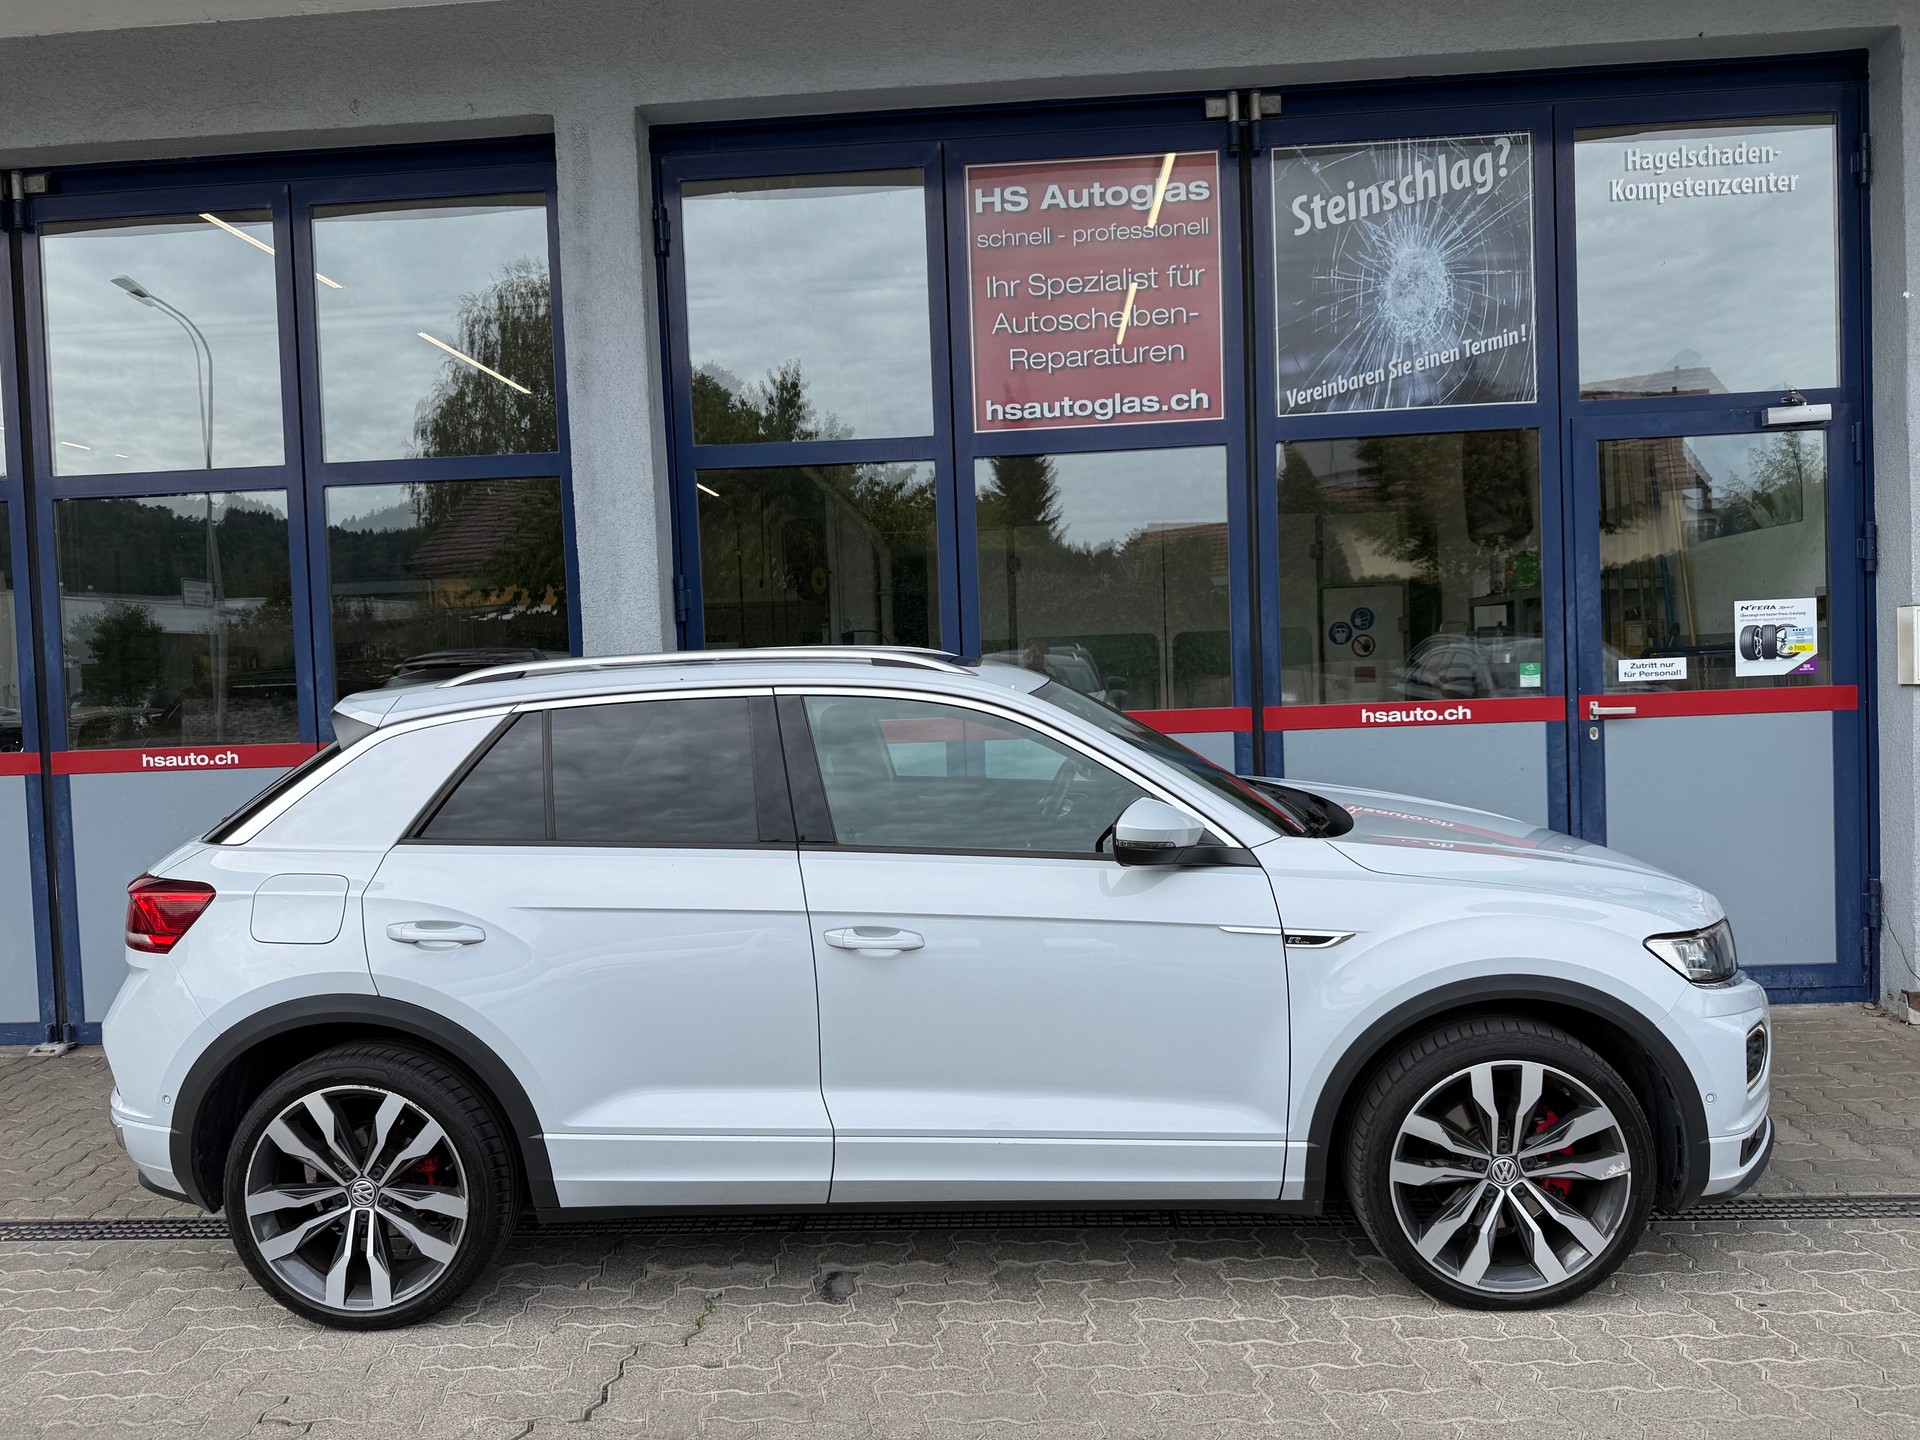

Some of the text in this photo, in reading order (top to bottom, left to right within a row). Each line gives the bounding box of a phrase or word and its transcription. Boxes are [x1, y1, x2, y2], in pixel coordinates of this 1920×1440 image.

[1626, 141, 1782, 175] Hagelschaden-
[974, 177, 1210, 213] HS Autogas
[1291, 137, 1511, 236] Steinschlag?
[1609, 171, 1799, 204] Kompetenzcenter
[977, 227, 1050, 248] schnell
[1073, 217, 1209, 246] professionell
[986, 264, 1205, 300] Ihr Spezialist für
[1009, 343, 1184, 373] Reparaturen
[1286, 366, 1385, 408] Vereinbaren
[1388, 360, 1412, 379] Sie
[1415, 345, 1460, 372] einen
[985, 388, 1209, 420] hsautoglas.ch
[1638, 669, 1682, 677] Personal!
[1361, 705, 1472, 723] hsauto.ch
[141, 750, 239, 767] hsauto.ch
